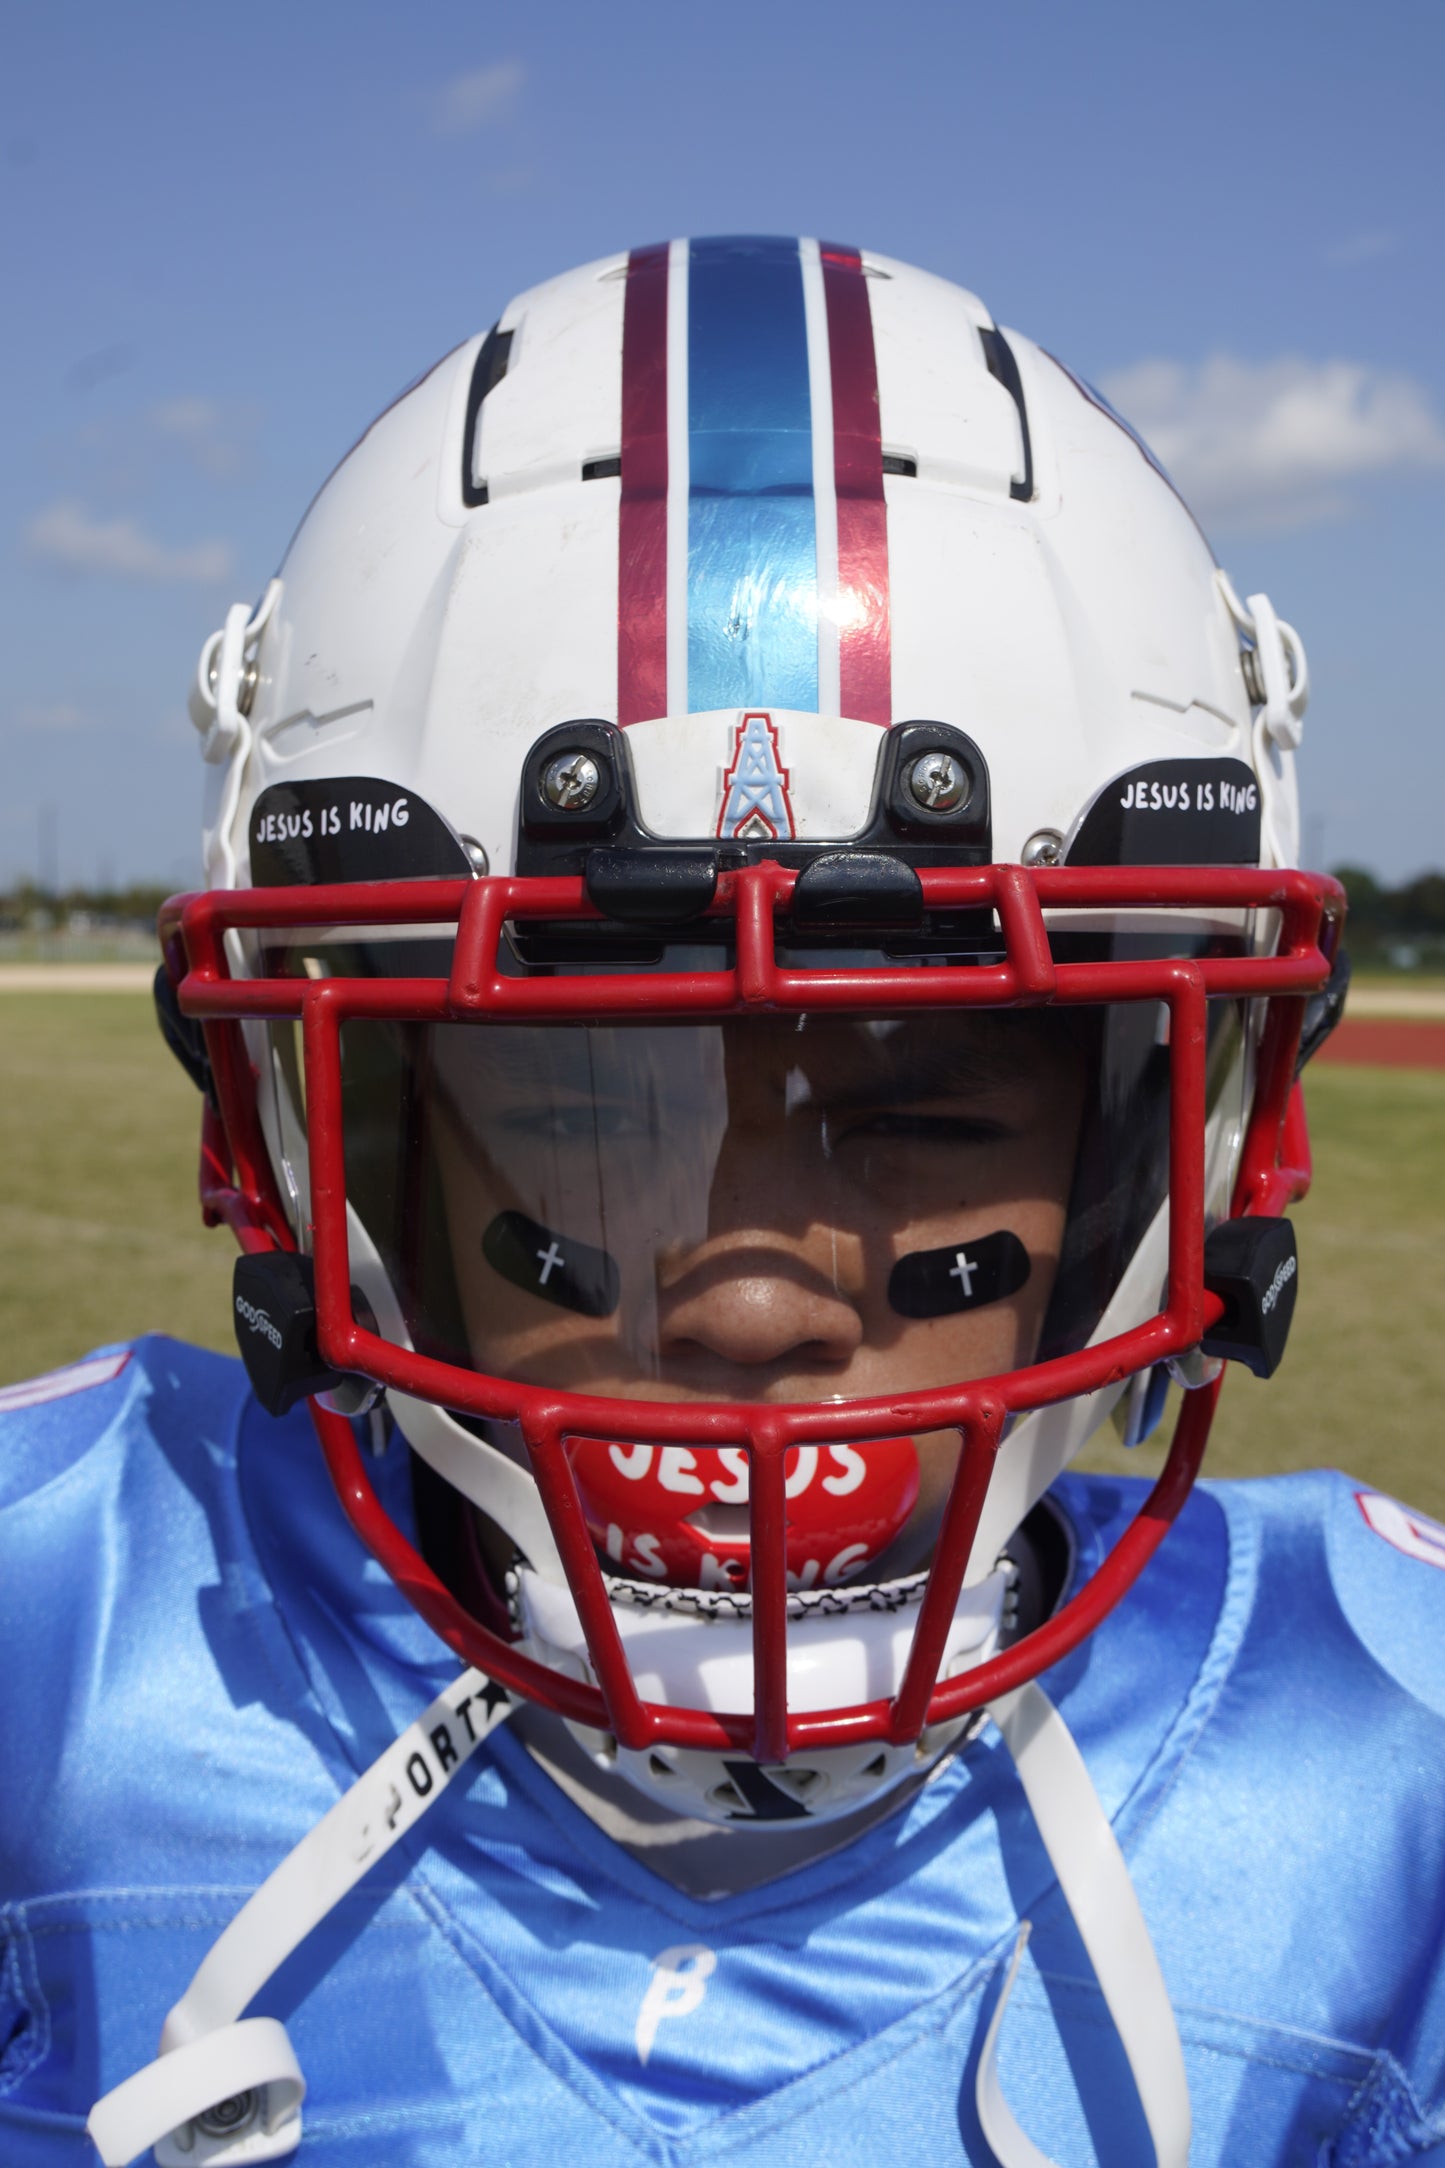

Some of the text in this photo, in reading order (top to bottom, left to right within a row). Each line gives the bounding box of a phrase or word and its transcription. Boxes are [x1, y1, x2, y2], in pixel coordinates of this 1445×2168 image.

[256, 798, 409, 843] JESUS IS KING
[1120, 781, 1257, 815] JESUS IS KING
[236, 1296, 283, 1350] GODSPEED
[606, 1522, 868, 1593] IS KNG
